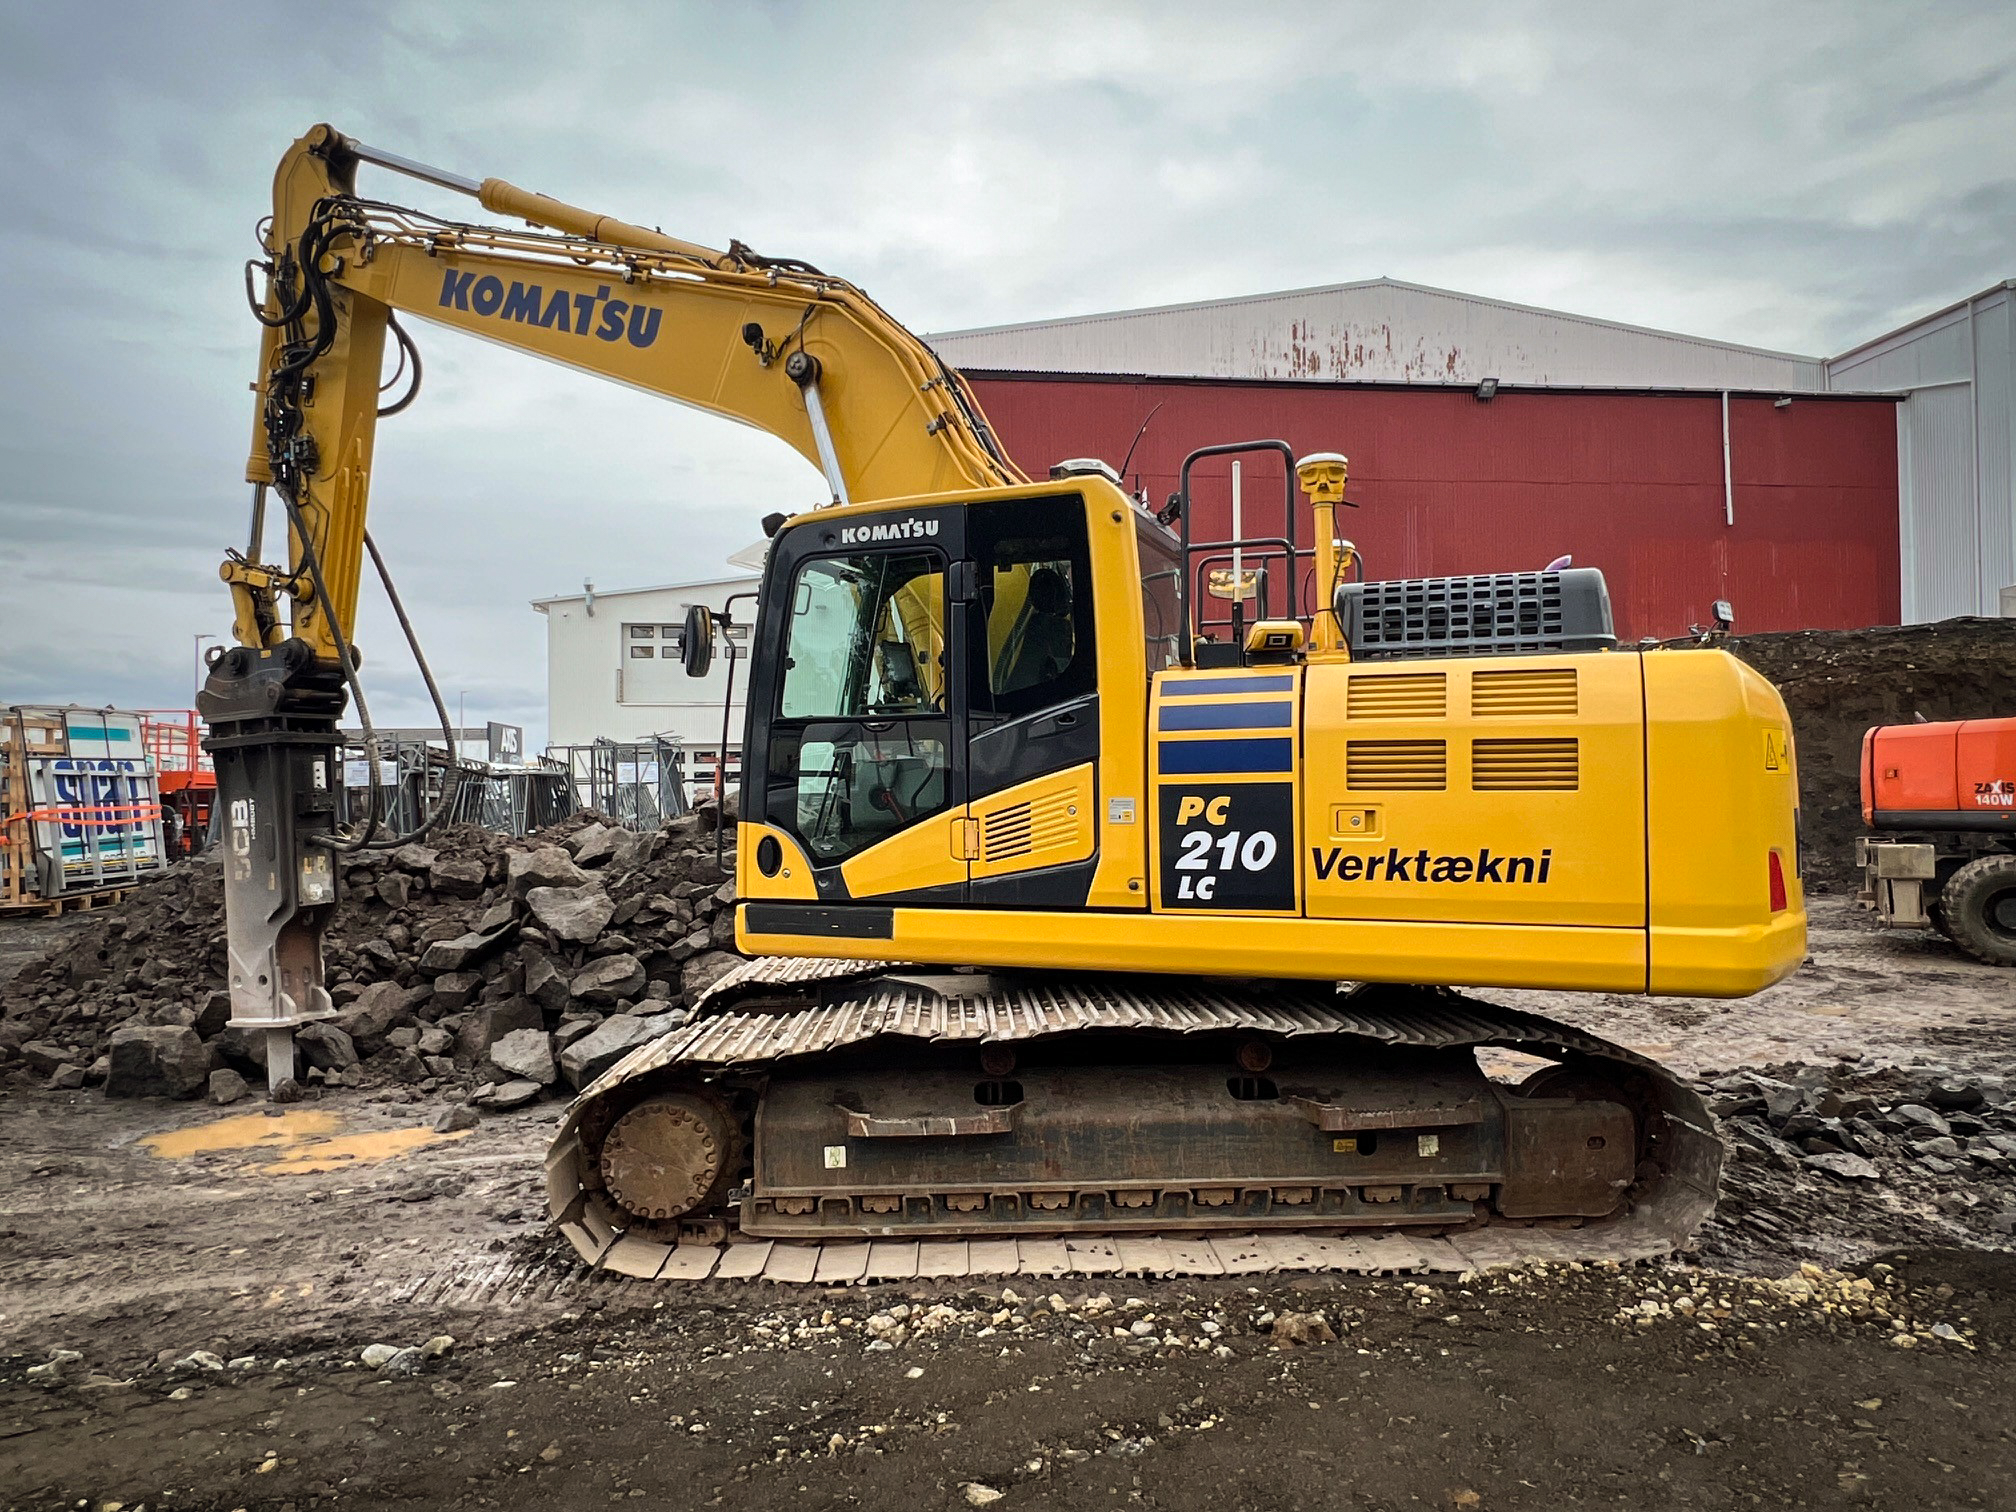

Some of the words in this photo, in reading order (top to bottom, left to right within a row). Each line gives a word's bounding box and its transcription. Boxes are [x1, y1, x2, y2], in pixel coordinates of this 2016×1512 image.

[439, 268, 663, 348] KOMATSU
[841, 518, 939, 544] KOMATSU
[1974, 779, 2015, 794] ZAXIS
[1975, 793, 2014, 806] 140W
[1175, 796, 1231, 826] PC
[231, 799, 252, 880] JCB
[1174, 830, 1277, 872] 210
[1311, 847, 1553, 884] Verktækni
[1177, 875, 1217, 900] LC
